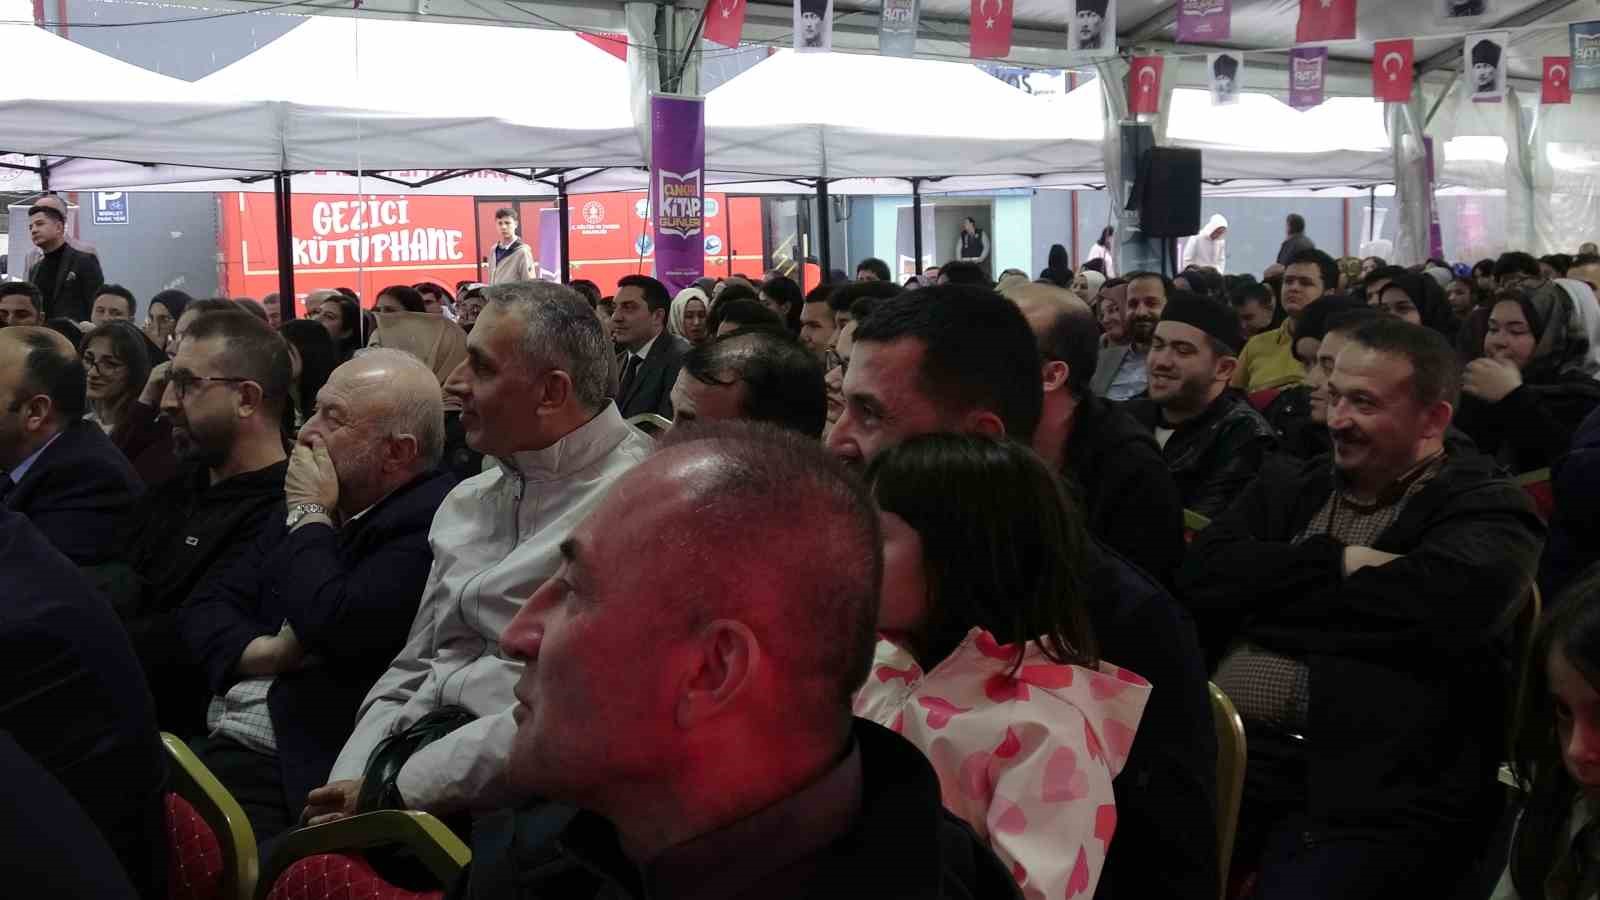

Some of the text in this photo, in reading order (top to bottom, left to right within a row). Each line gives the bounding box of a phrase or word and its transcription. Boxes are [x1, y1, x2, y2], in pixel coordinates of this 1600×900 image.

[98, 191, 122, 210] P
[312, 195, 410, 235] GEZİCİ
[659, 197, 701, 217] KİTAP
[293, 227, 463, 266] KÜTÜPHANE
